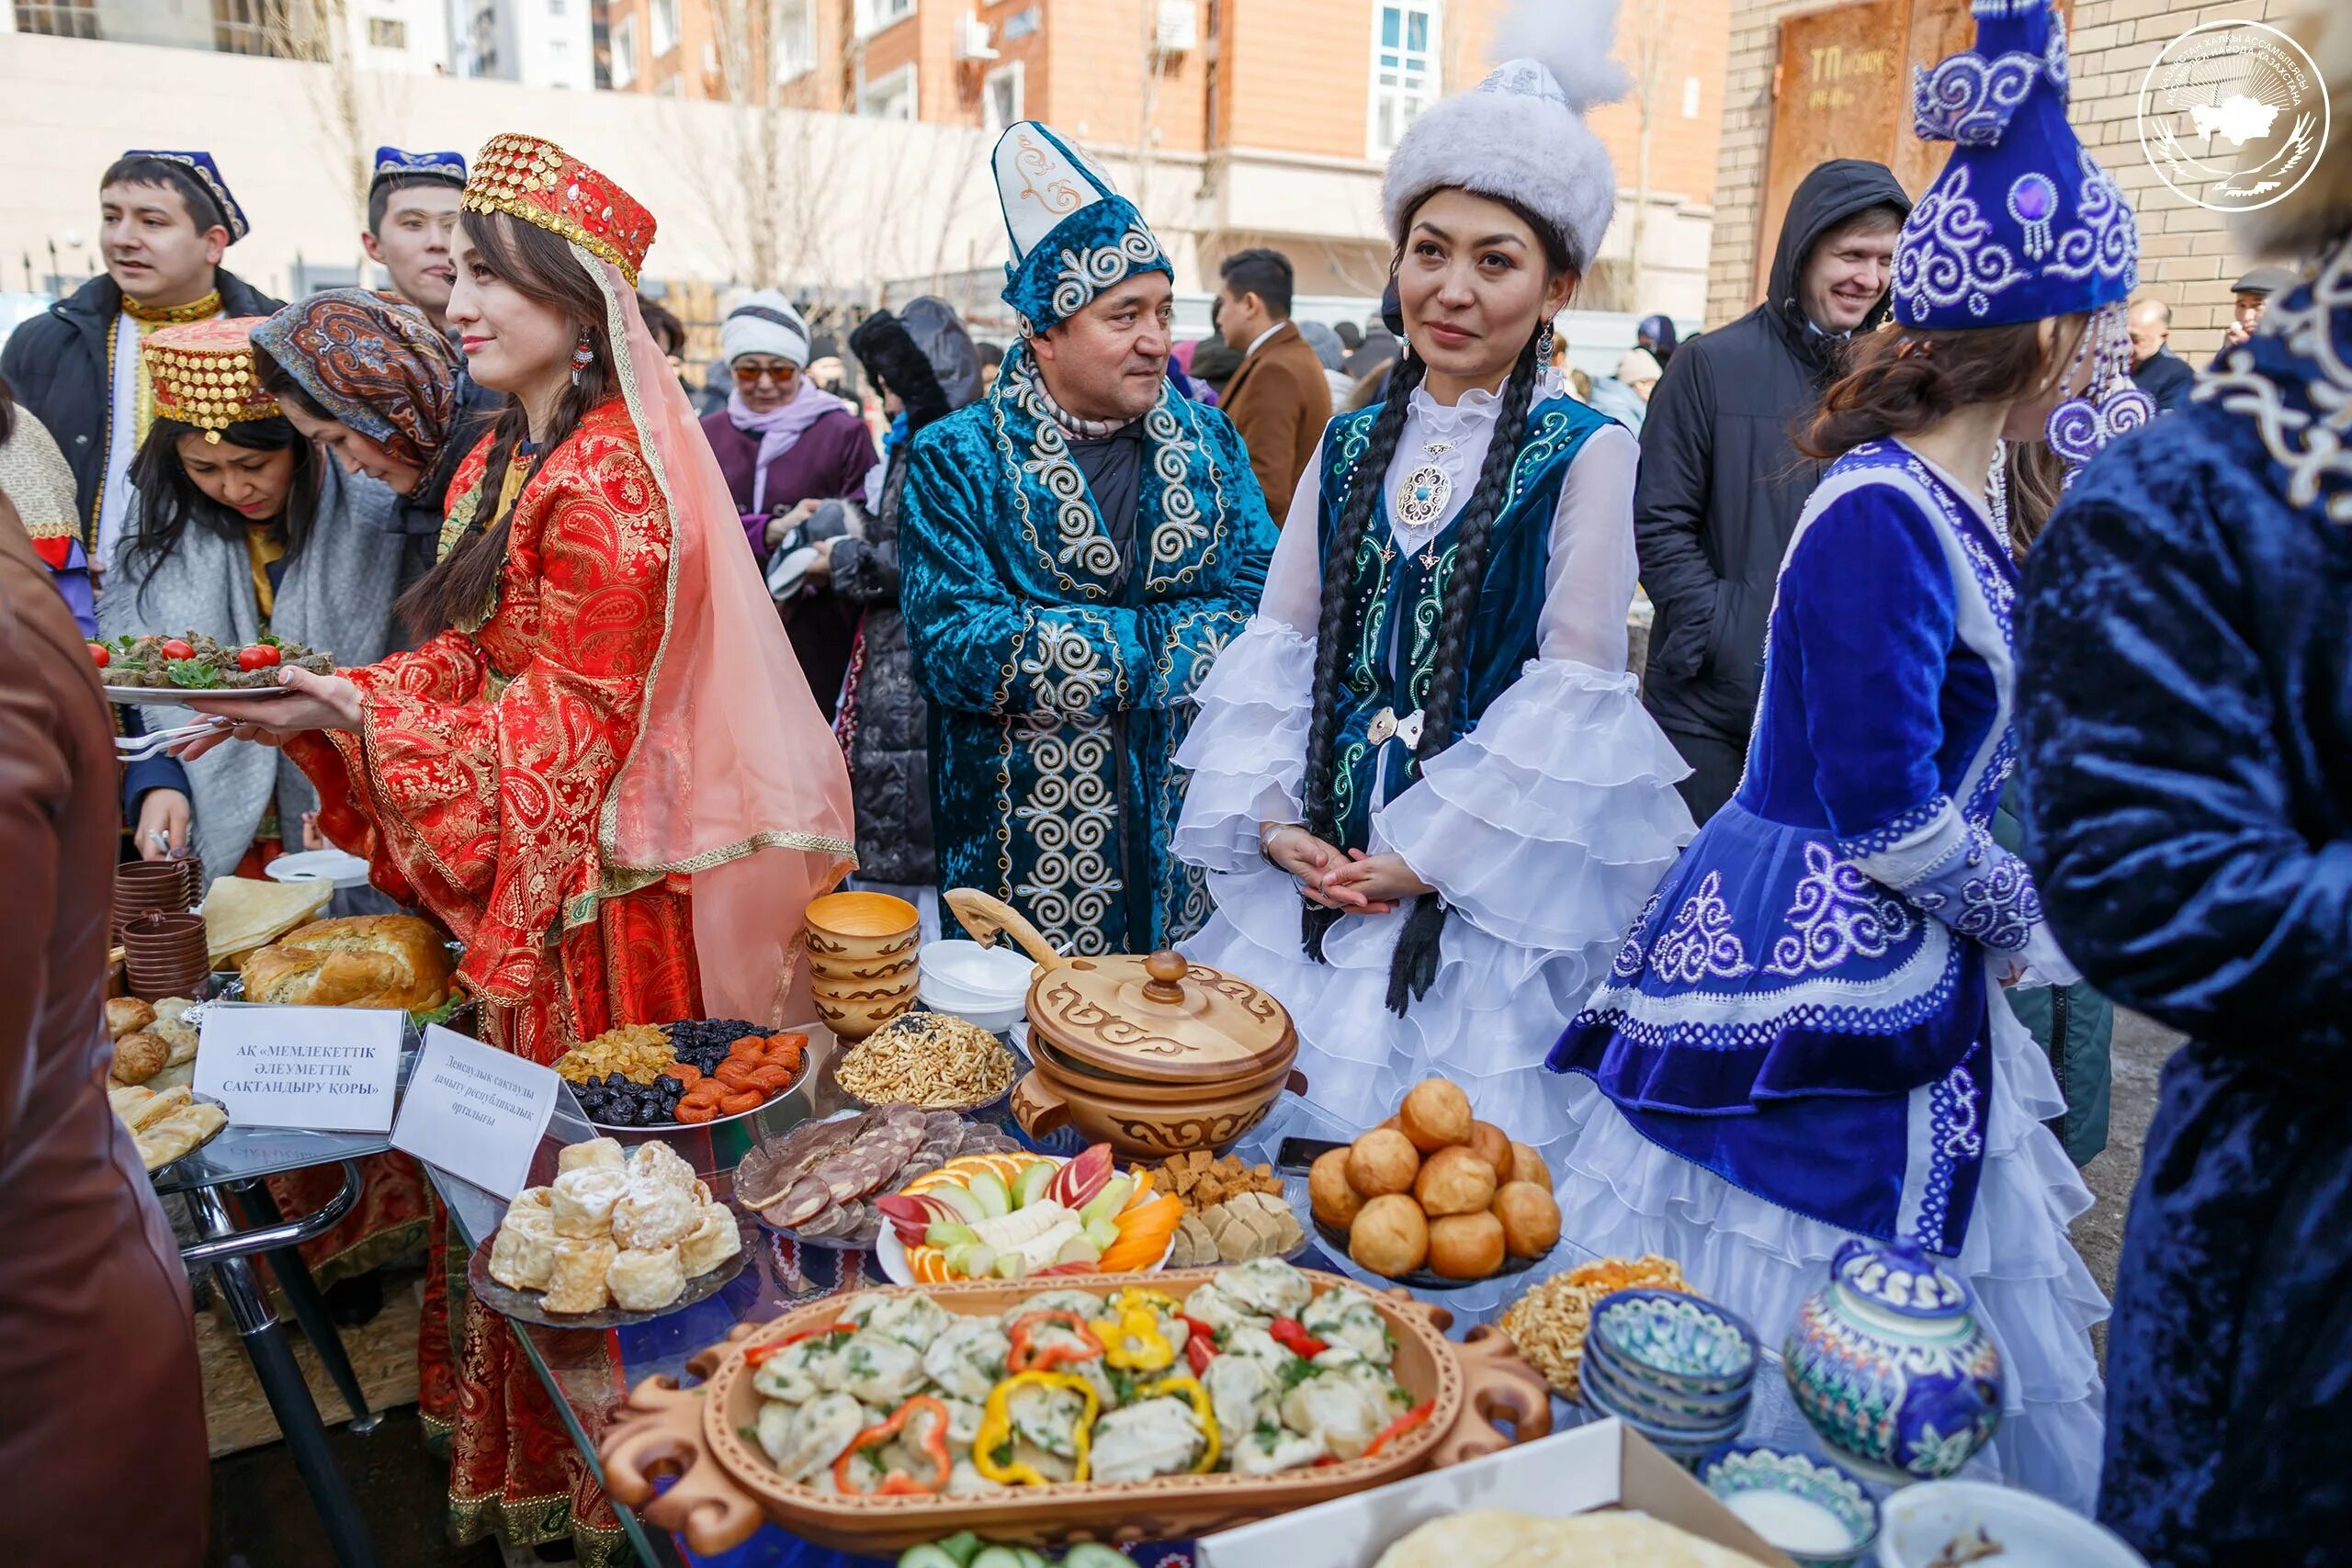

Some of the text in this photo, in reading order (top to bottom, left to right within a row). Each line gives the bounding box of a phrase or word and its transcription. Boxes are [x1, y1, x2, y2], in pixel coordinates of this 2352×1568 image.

[236, 1044, 376, 1058] АҚ «МЕМЛЕКЕТТІК
[254, 1064, 353, 1077] ӘЛЕУМЕТТІК
[222, 1080, 379, 1095] САҚТАНДЫРУ ҚОРЫ»
